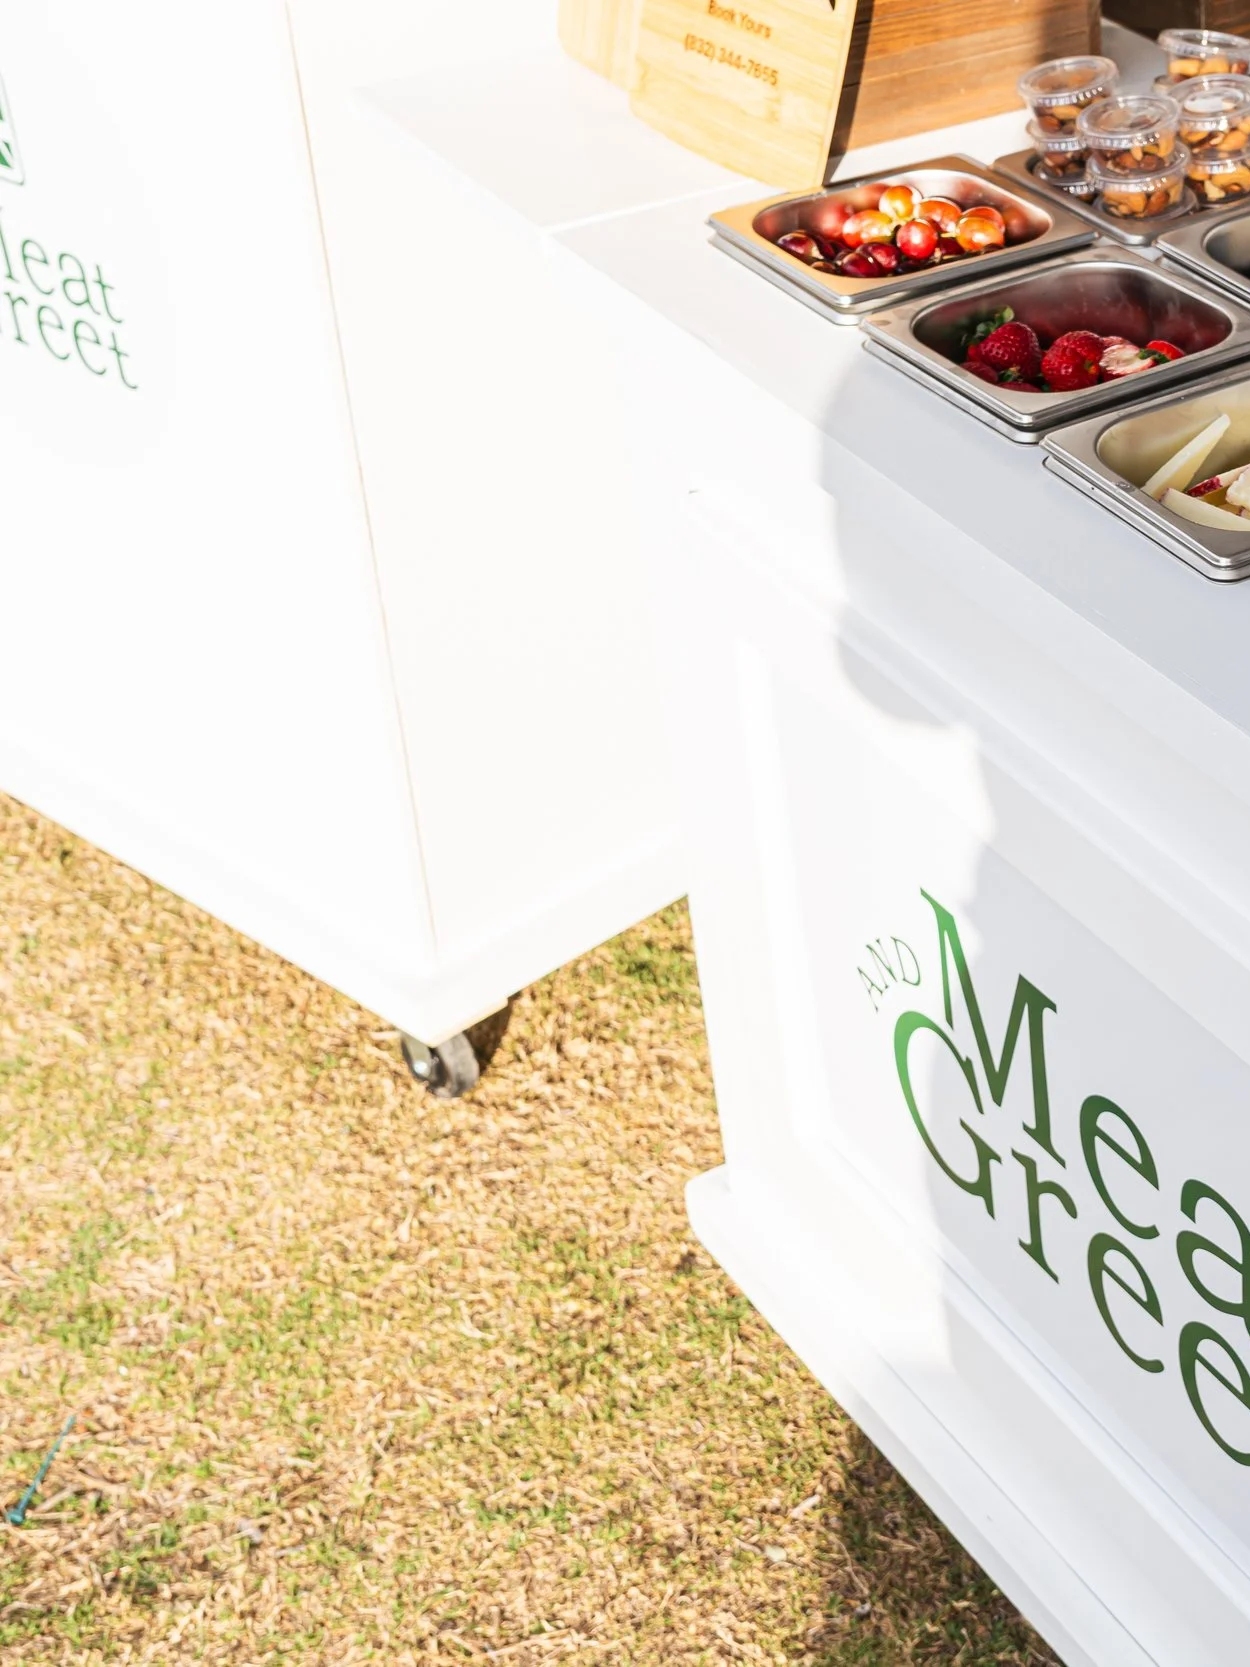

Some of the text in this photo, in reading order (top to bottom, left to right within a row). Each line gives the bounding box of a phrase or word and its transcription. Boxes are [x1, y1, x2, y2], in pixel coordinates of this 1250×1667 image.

[685, 33, 715, 61] (832)
[739, 12, 771, 39] Yours
[0, 288, 139, 391] reet
[857, 935, 921, 1014] AND
